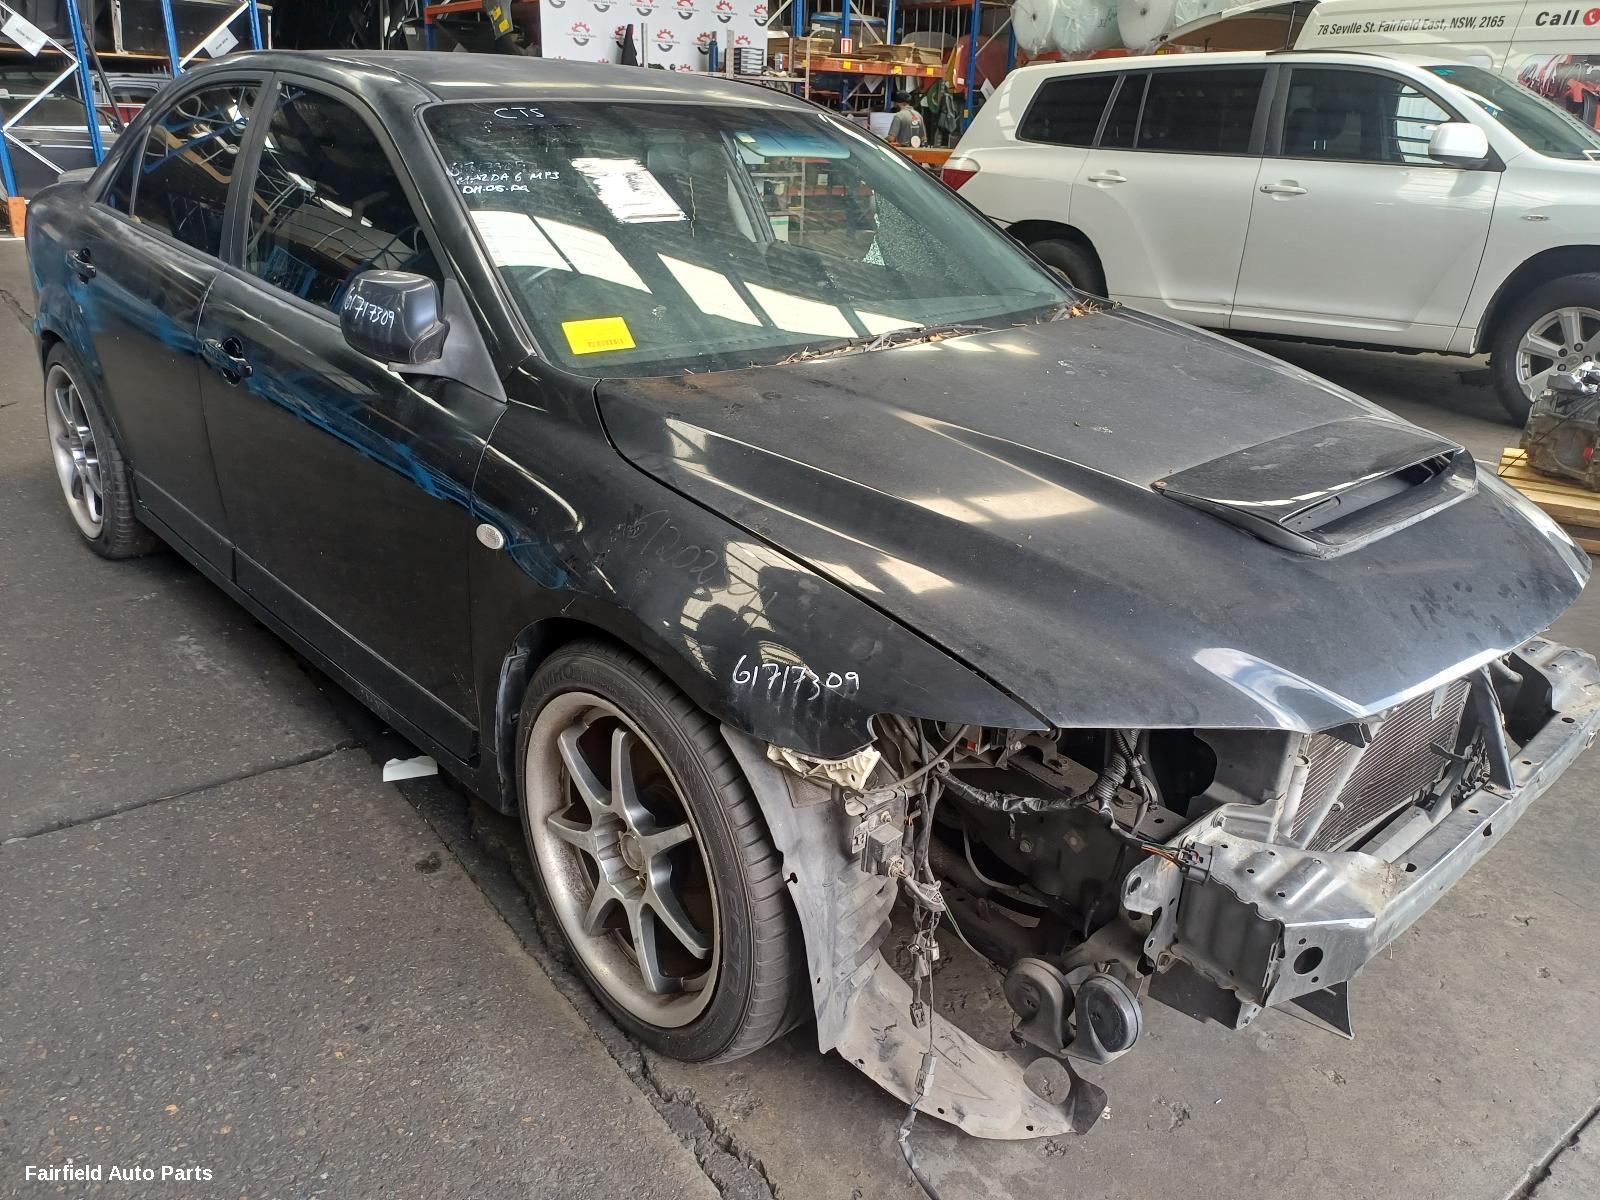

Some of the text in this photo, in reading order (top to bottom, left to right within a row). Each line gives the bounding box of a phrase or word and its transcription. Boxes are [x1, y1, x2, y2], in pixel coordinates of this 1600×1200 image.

[1317, 24, 1329, 36] 78
[1330, 22, 1362, 35] Seville
[1363, 21, 1375, 33] St.
[1421, 18, 1447, 31] East,
[1449, 16, 1477, 30] NSW,
[1479, 15, 1506, 28] 2165
[1535, 9, 1580, 27] Call
[344, 286, 395, 328] 61717309
[732, 654, 860, 701] 61717309
